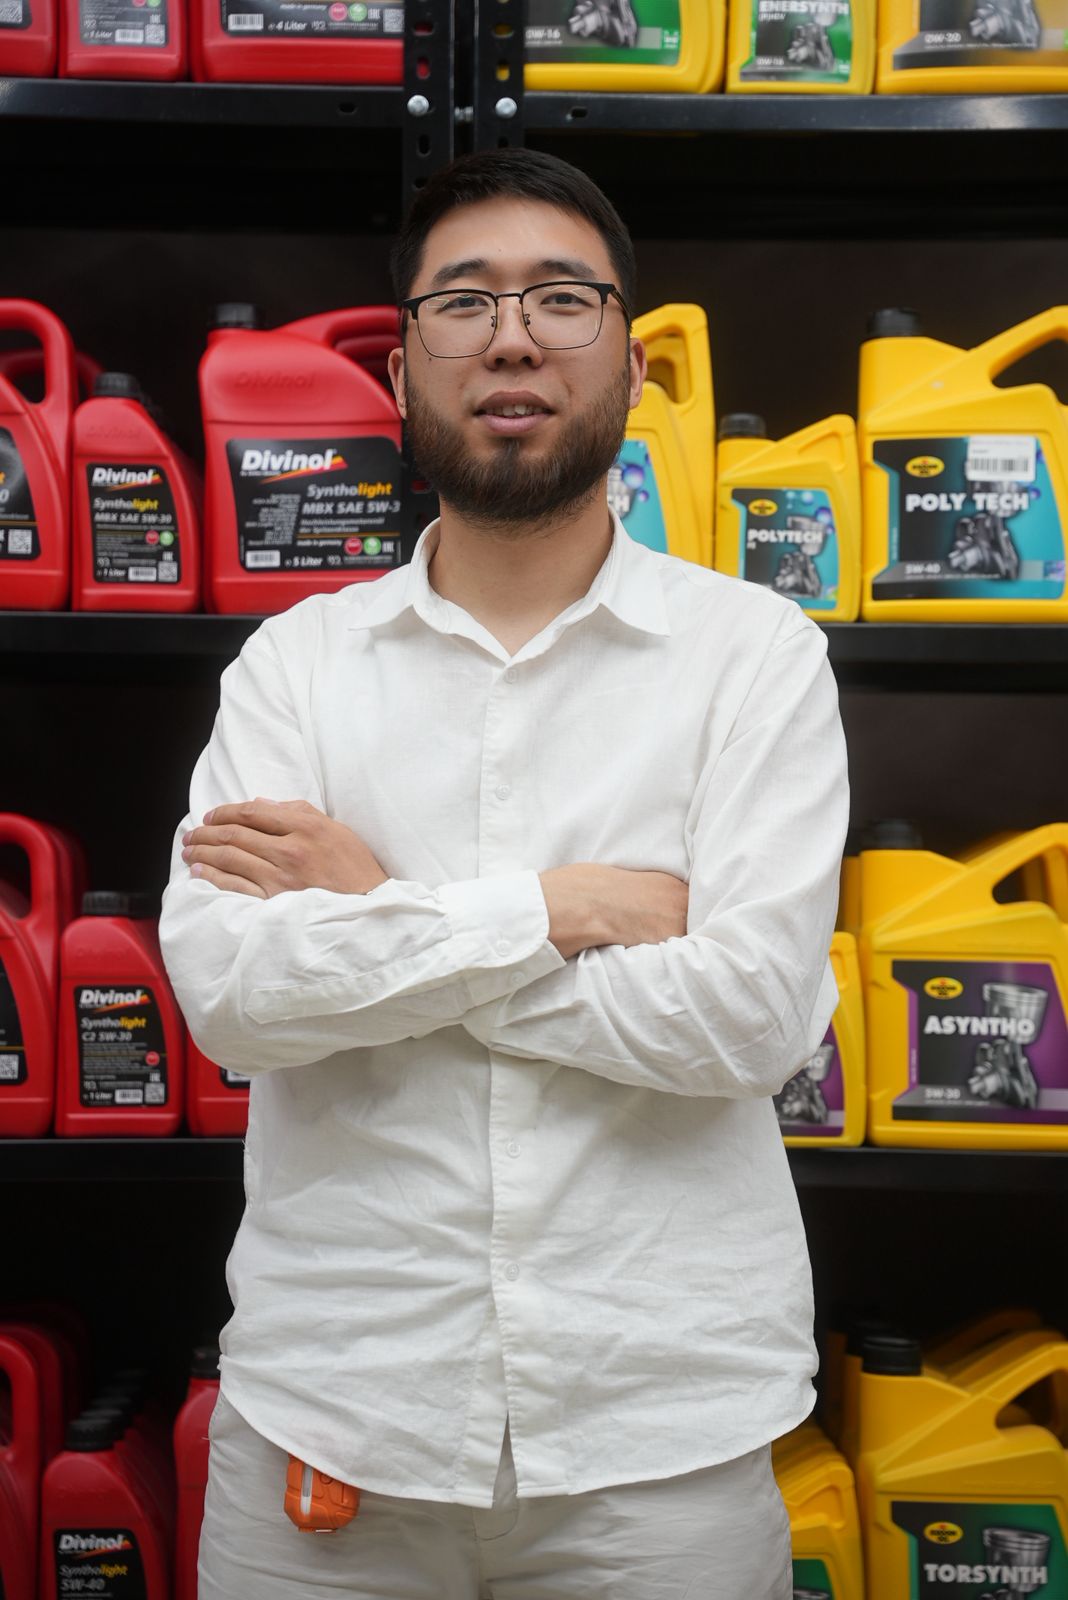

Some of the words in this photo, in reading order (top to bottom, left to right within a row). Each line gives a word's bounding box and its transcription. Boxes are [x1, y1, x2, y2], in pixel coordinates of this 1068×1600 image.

[284, 21, 307, 30] Liter
[241, 449, 333, 470] Divinol
[92, 467, 154, 484] Divinol
[307, 483, 392, 500] Syntholight
[93, 497, 159, 512] Syntholight
[302, 502, 334, 515] MBX
[337, 502, 363, 515] SAE
[366, 501, 401, 514] 5W-3
[905, 492, 967, 512] POLY
[973, 492, 1029, 511] TECH
[94, 512, 118, 523] MBX
[120, 513, 140, 523] SAE
[141, 514, 172, 524] 5W-30
[747, 529, 823, 544] POLYTECH
[292, 557, 299, 567] 5
[301, 556, 322, 567] Liter
[905, 563, 941, 574] 5W-40
[80, 989, 142, 1004] Divinol
[81, 1017, 147, 1029] Syntholight
[924, 1014, 1036, 1037] ASYNTHO
[81, 1031, 96, 1042] C2
[98, 1031, 132, 1042] 5W-30
[59, 1533, 124, 1550] Divinol
[59, 1564, 128, 1578] Syntholight
[923, 1563, 1049, 1584] TORSYNTH
